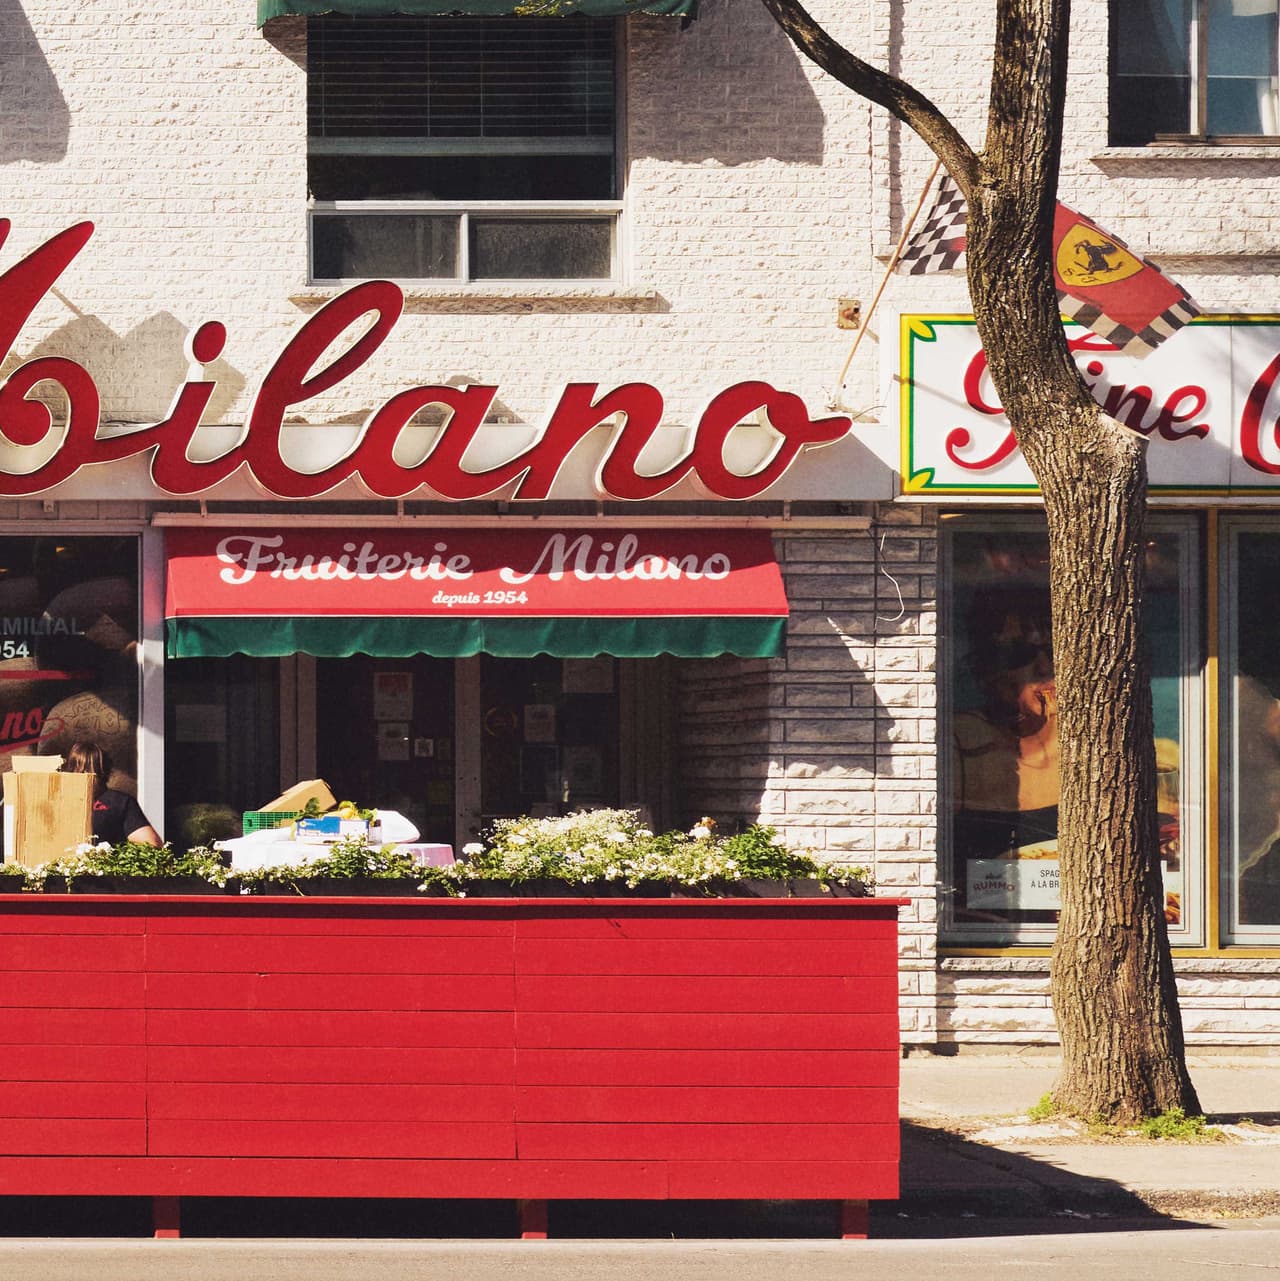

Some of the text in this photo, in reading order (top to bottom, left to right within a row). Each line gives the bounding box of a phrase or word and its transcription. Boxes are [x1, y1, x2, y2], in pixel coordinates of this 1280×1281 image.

[216, 533, 730, 585] Fruiterie Milano
[431, 590, 529, 606] depuis 1954
